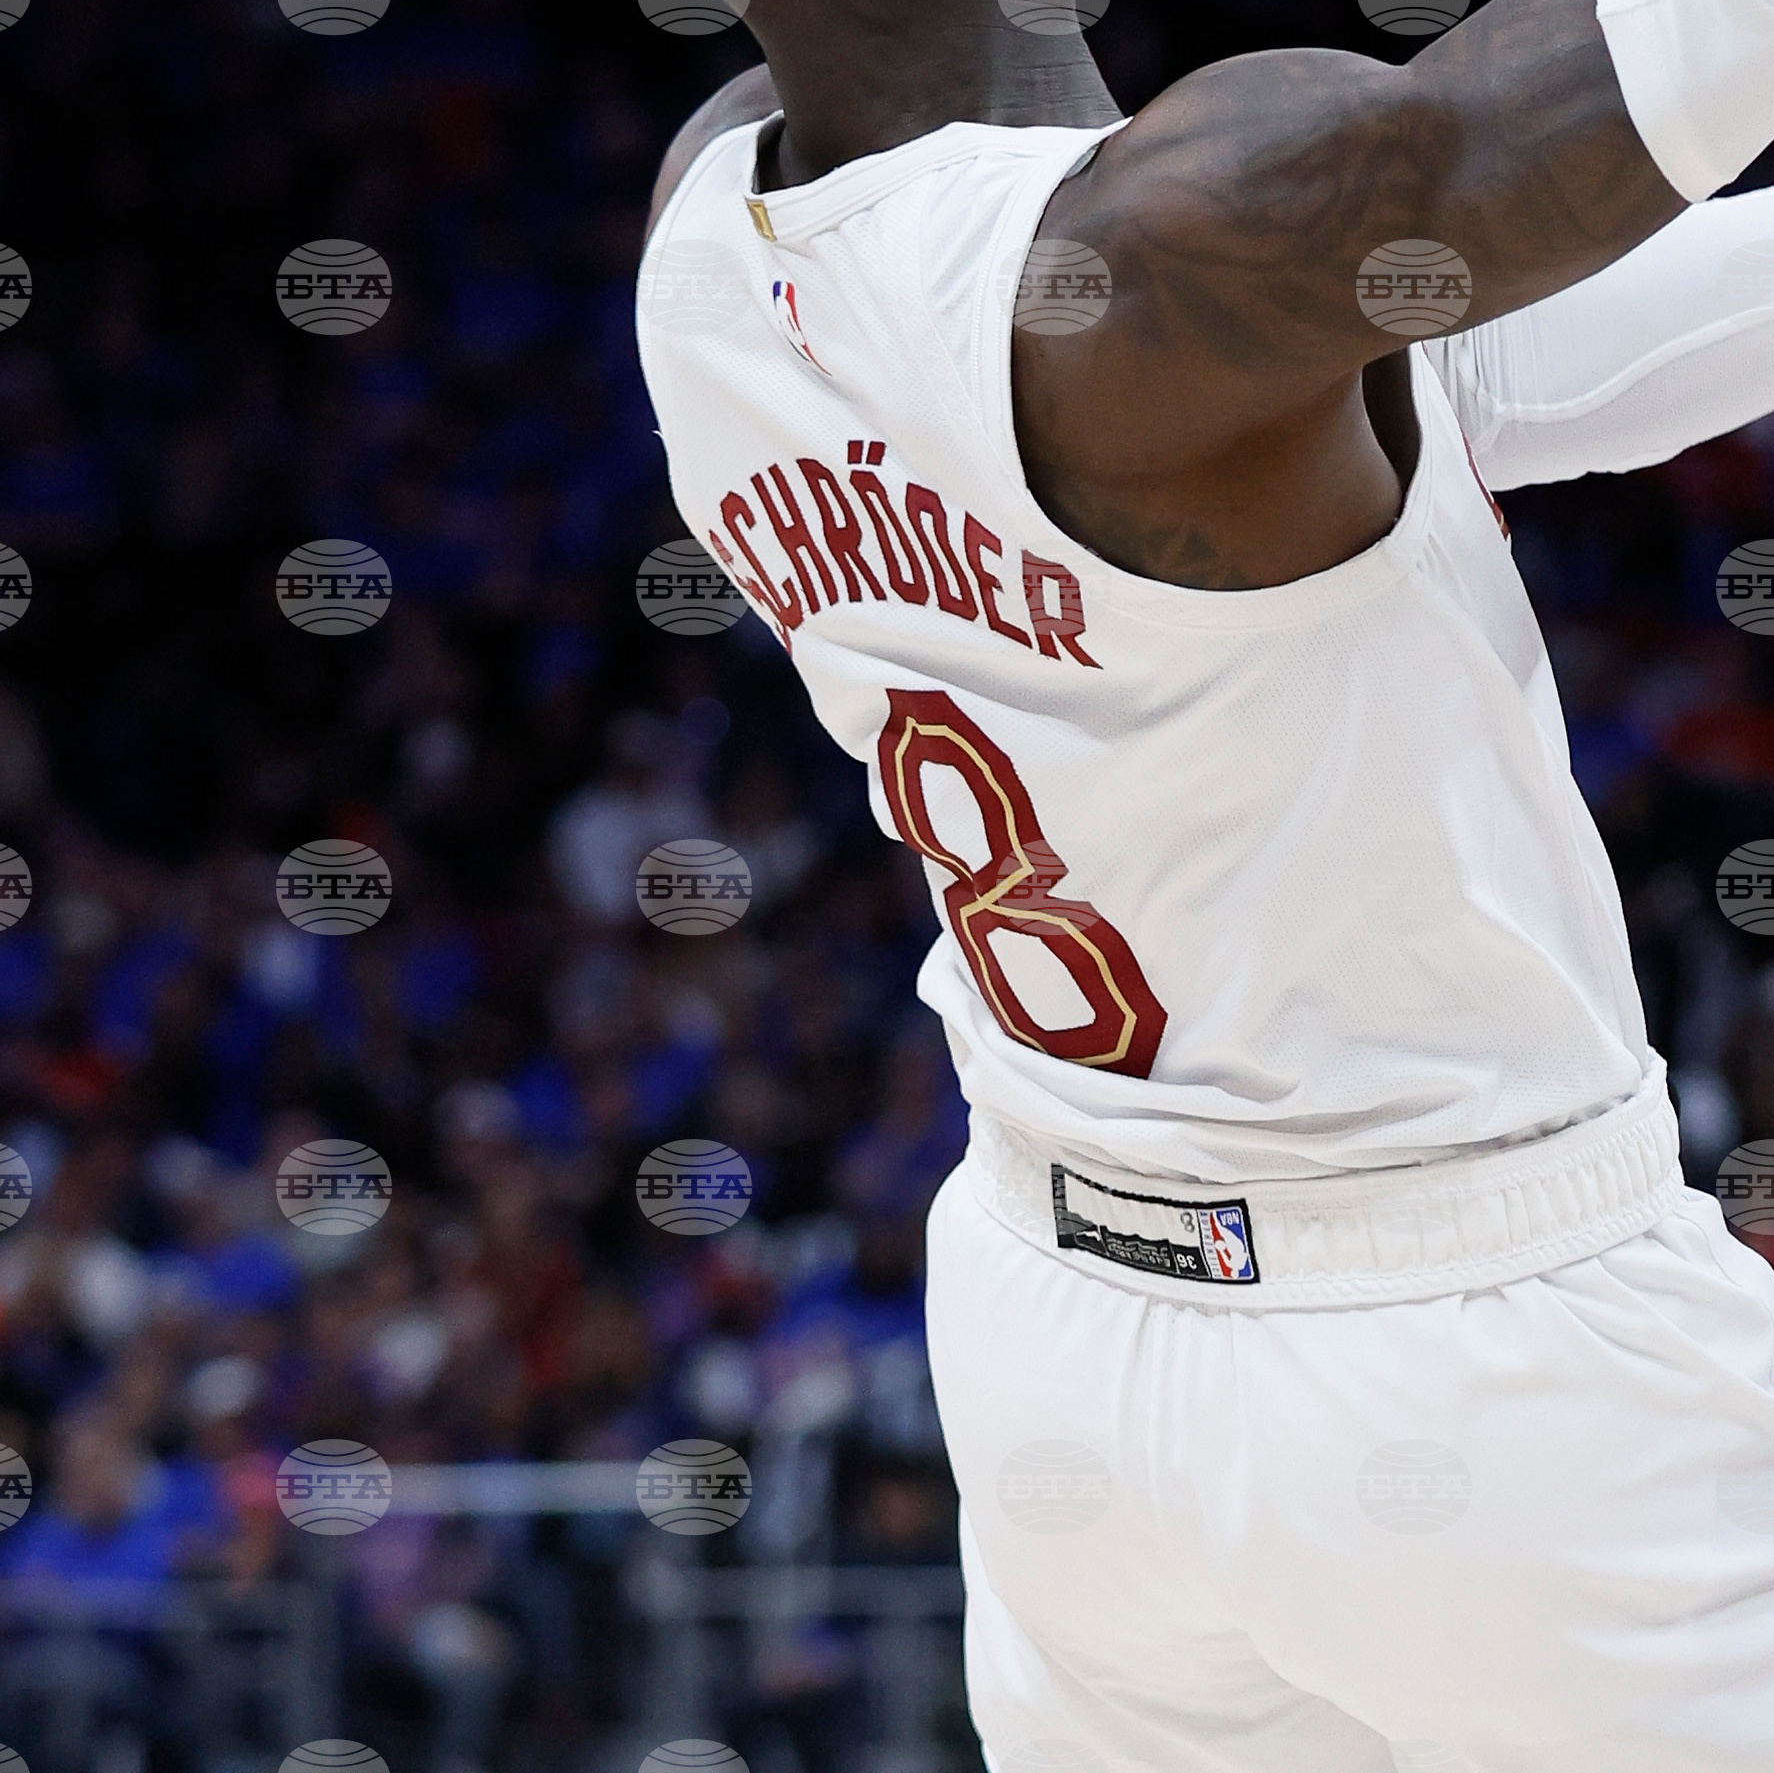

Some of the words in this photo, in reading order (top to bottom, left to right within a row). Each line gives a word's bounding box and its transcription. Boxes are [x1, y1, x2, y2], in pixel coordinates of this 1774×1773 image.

[708, 439, 1104, 669] SCHRÖDER
[877, 689, 1168, 1080] 8
[1178, 1253, 1197, 1270] 36
[1220, 1211, 1240, 1226] NBA
